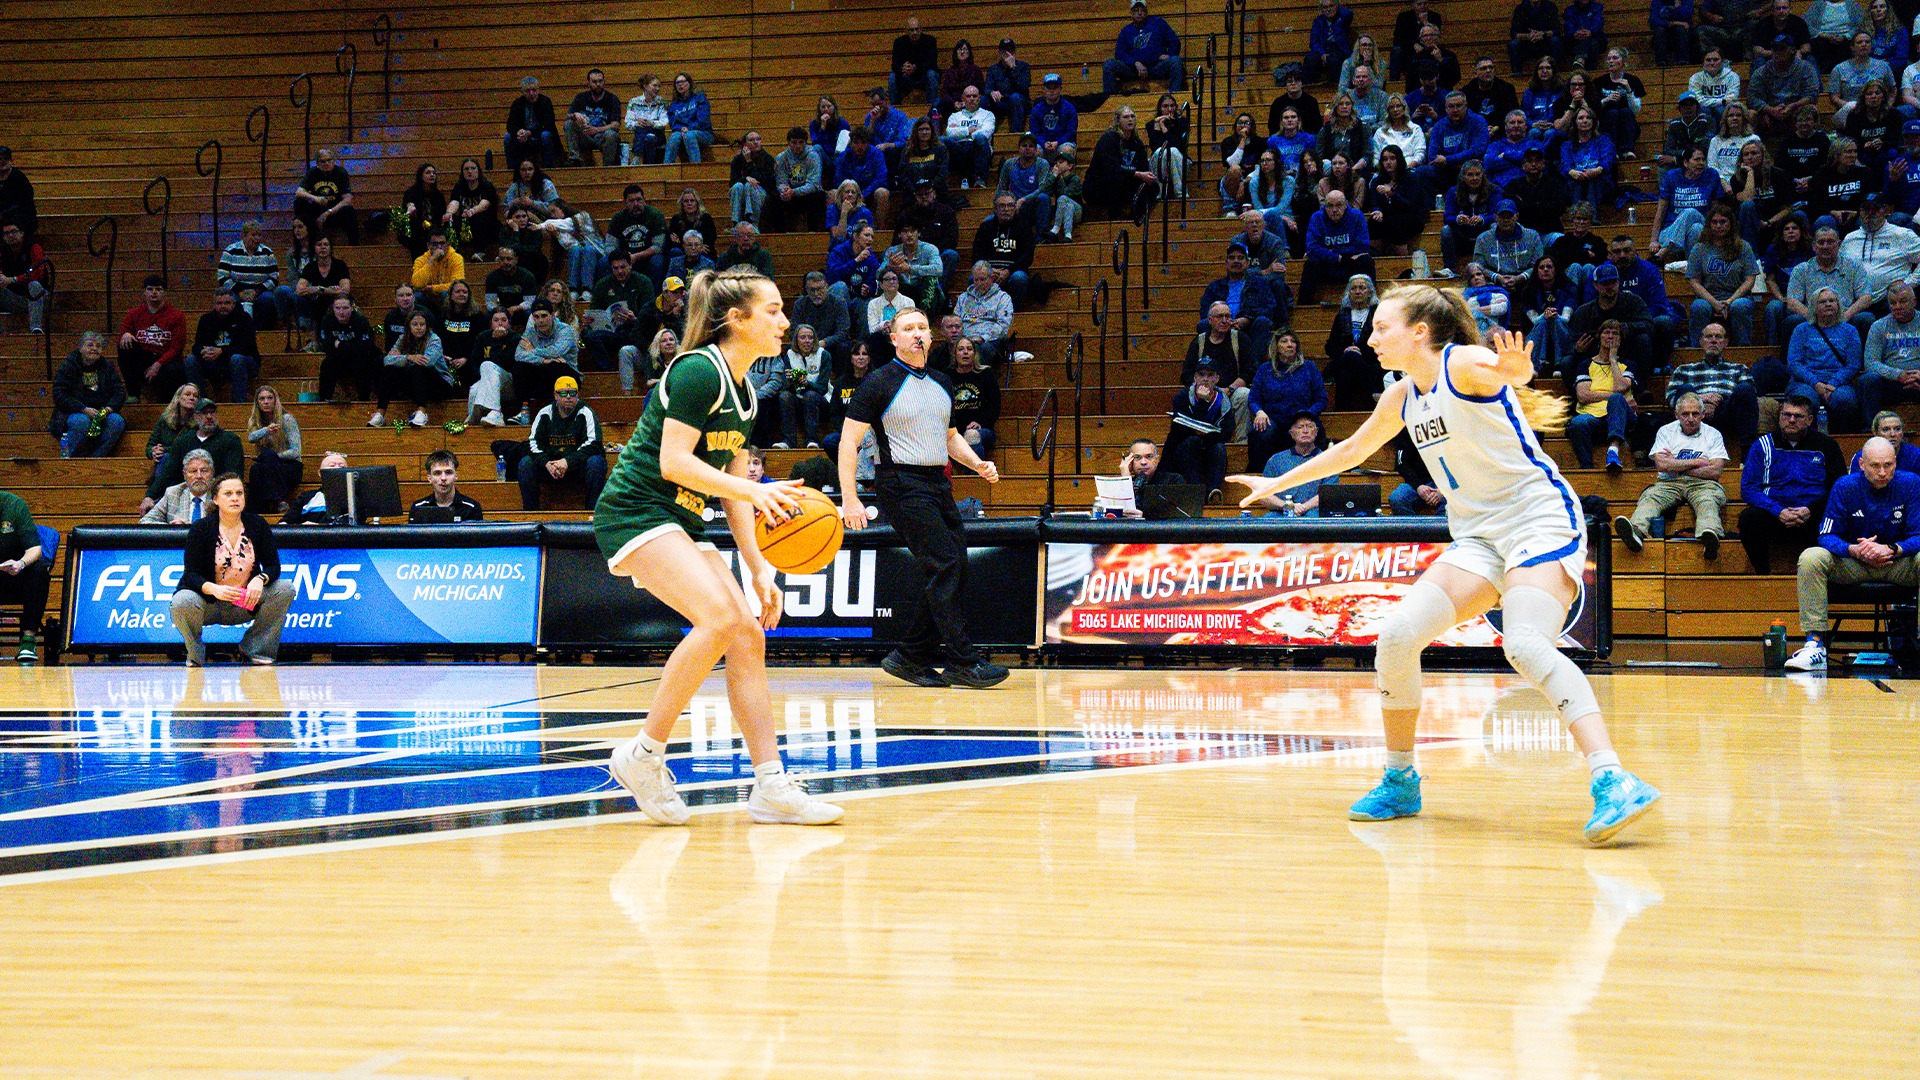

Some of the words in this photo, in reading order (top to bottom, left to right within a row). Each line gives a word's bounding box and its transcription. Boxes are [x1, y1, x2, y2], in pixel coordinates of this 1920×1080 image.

[1325, 234, 1350, 246] GVSU
[1885, 338, 1920, 350] LAKER
[1414, 416, 1448, 443] GVSU
[1438, 456, 1459, 490] 1
[397, 564, 459, 580] GRAND
[461, 563, 526, 582] RAPIDS,
[1072, 571, 1134, 605] JOIN
[1141, 566, 1177, 600] US
[1182, 560, 1267, 596] AFTER
[1275, 553, 1325, 588] THE
[1330, 545, 1420, 582] GAME!
[413, 585, 504, 601] MICHIGAN
[720, 550, 877, 617] VSU
[107, 608, 165, 628] Make
[1079, 613, 1107, 628] 5065
[1111, 614, 1141, 628] LAKE
[1144, 613, 1202, 628] MICHIGAN
[1207, 613, 1242, 628] DRIVE
